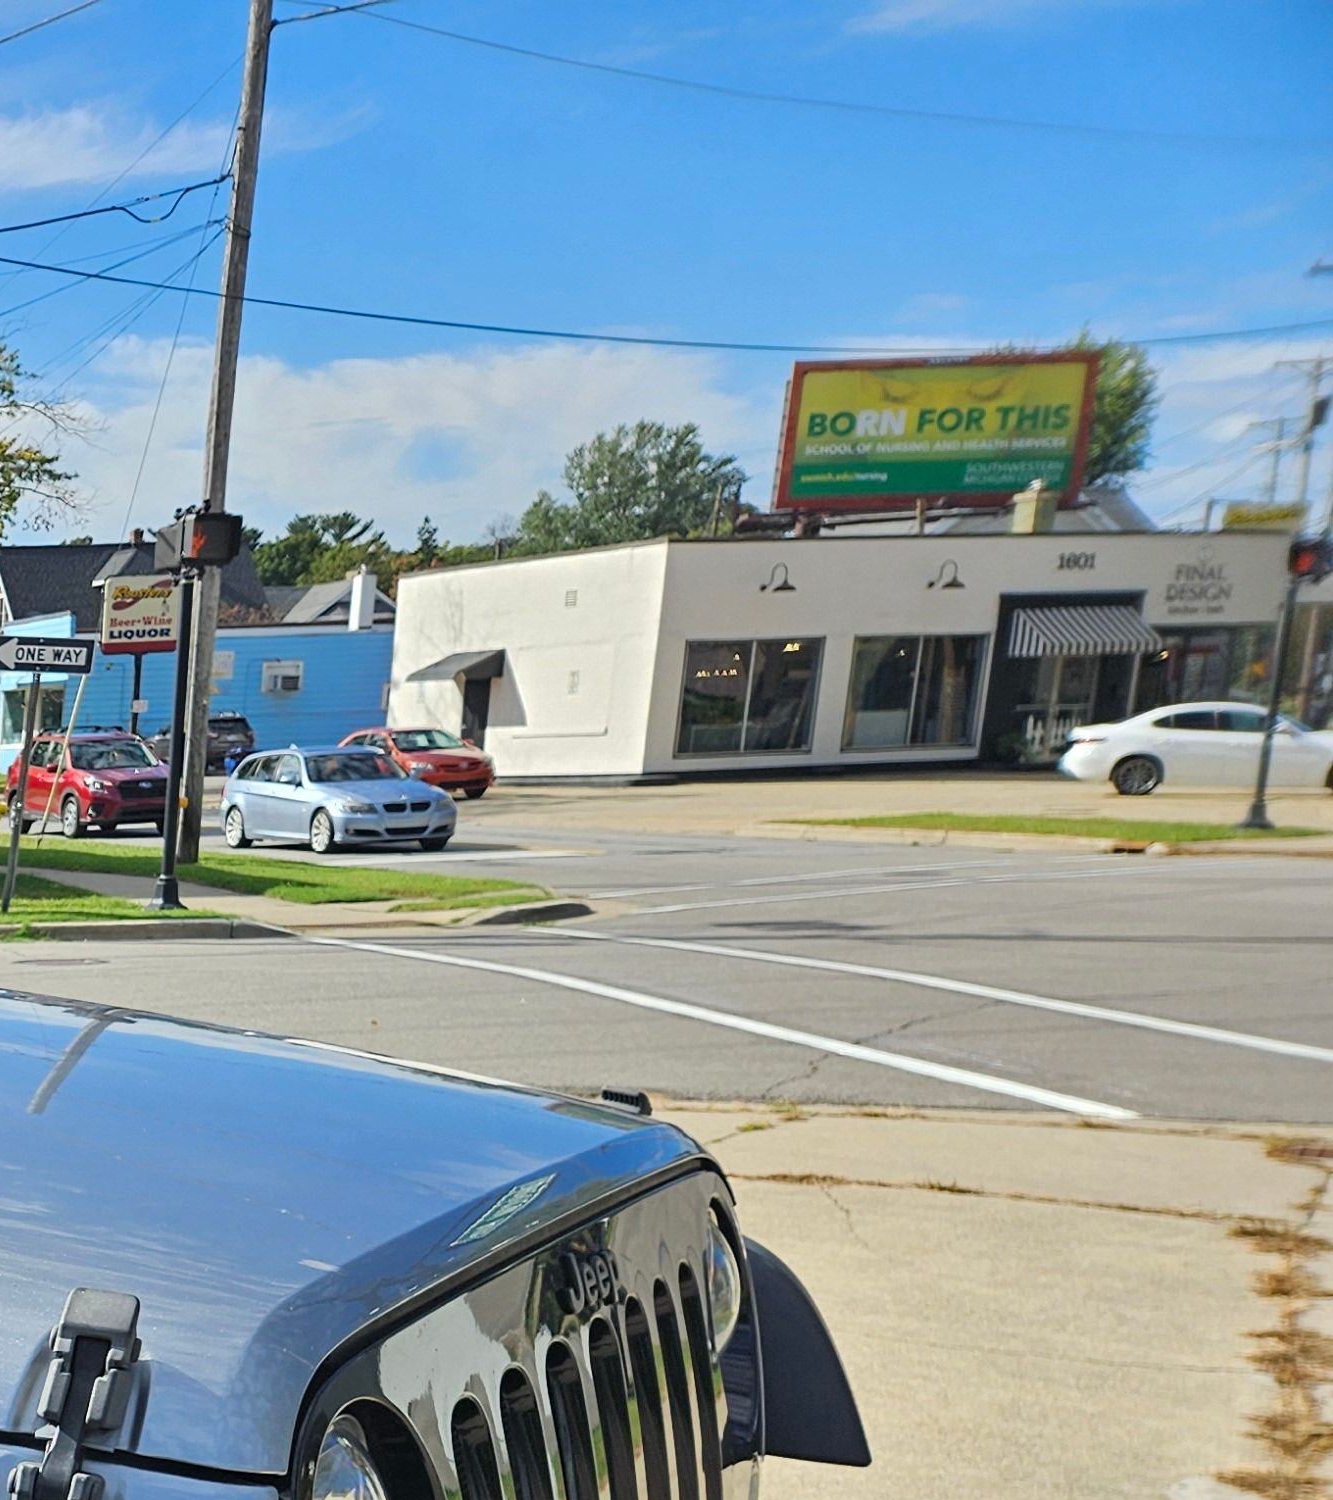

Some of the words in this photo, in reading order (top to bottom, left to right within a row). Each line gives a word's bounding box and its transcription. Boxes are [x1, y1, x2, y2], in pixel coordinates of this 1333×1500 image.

[806, 408, 908, 437] BORN
[917, 405, 988, 433] FOR
[997, 403, 1071, 431] THIS
[805, 443, 853, 456] SCHOOL
[857, 442, 873, 455] OF
[933, 439, 961, 451] AND
[1057, 551, 1097, 571] 1601
[1175, 563, 1228, 582] FINAL
[1165, 584, 1233, 603] DESIGN
[108, 628, 171, 640] LIQUOR
[15, 647, 46, 662] ONE
[52, 649, 83, 663] WAY
